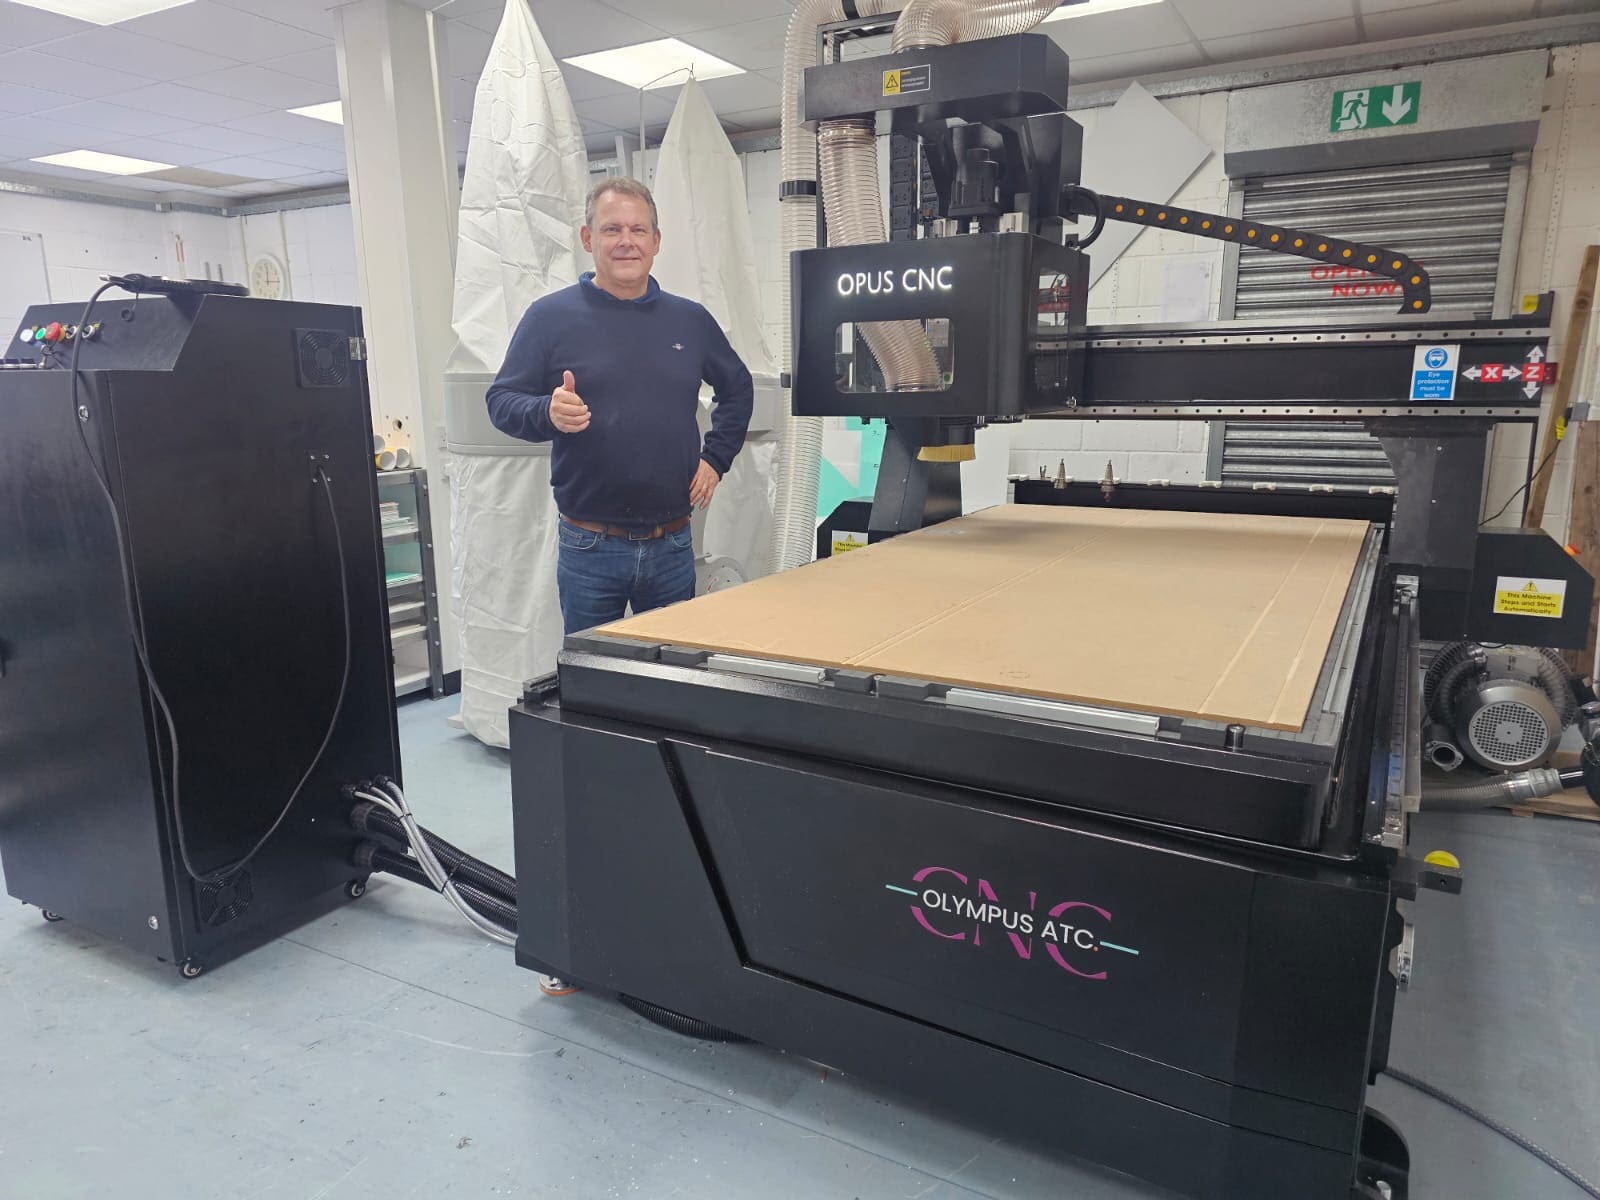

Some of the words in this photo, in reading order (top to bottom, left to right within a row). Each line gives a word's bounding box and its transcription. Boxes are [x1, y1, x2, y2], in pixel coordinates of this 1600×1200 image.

[837, 270, 894, 295] OPUS
[902, 265, 953, 292] CNC
[1484, 366, 1501, 379] X
[1525, 366, 1541, 379] Z
[1503, 606, 1552, 614] Automatically
[922, 889, 1034, 934] OLYMPUS
